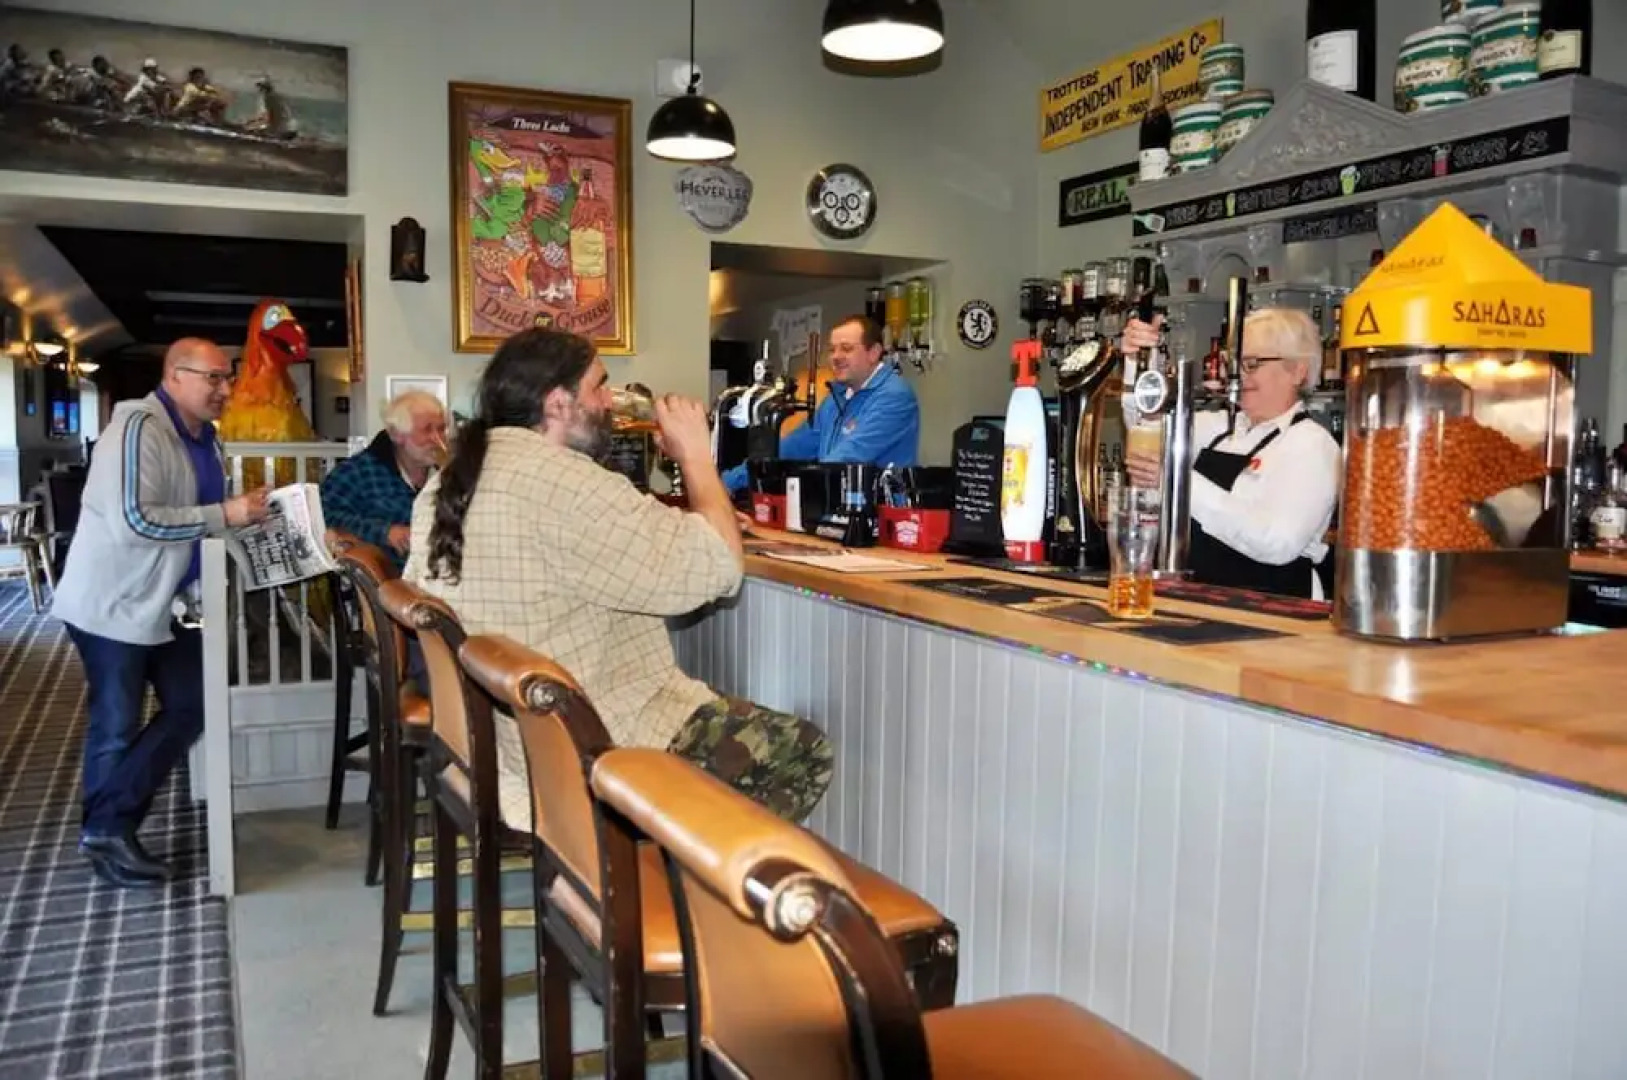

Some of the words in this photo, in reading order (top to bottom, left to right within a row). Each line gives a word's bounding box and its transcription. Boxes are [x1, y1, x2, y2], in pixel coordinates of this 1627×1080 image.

[1045, 76, 1123, 136] INDEPENDENT
[512, 117, 541, 132] Three
[478, 296, 528, 328] Duck
[555, 297, 612, 329] Grouse
[1452, 298, 1546, 327] SAHARAS
